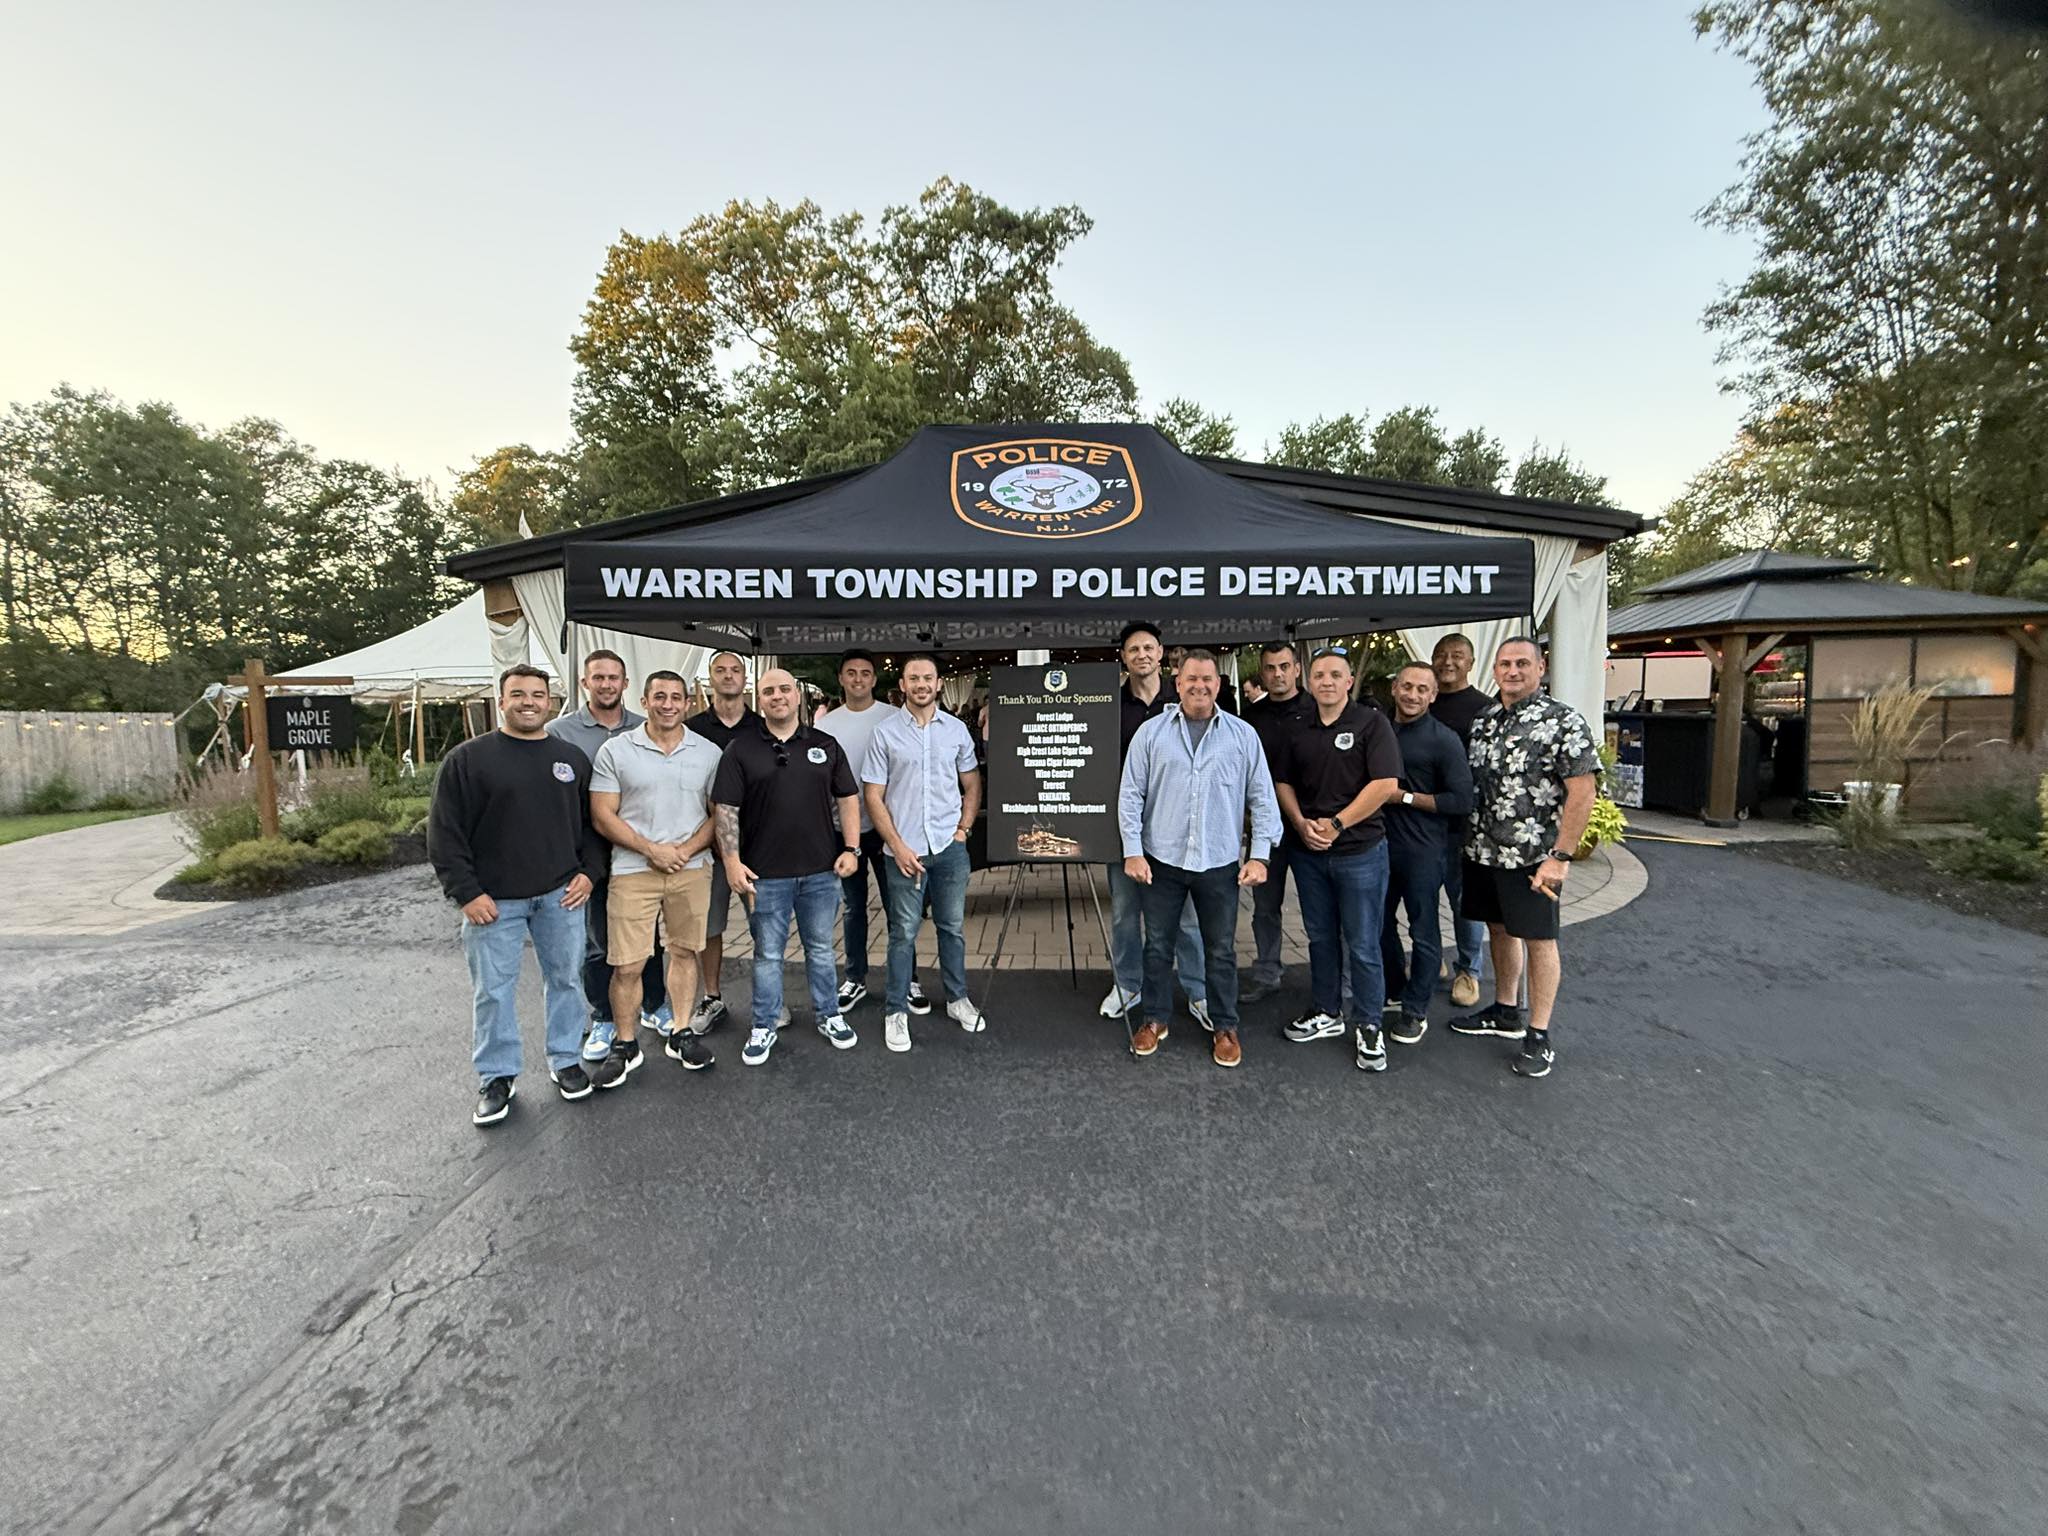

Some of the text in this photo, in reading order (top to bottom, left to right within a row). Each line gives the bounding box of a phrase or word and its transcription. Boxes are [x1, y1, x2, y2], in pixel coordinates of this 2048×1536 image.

[972, 446, 1112, 469] POLICE
[961, 479, 1129, 492] 19 72
[975, 500, 1121, 521] WARREN TWP.
[601, 565, 1500, 598] WARREN TOWNSHIP POLICE DEPARTMENT
[998, 694, 1112, 705] Thank You To Our Sponsors
[286, 710, 331, 726] MAPLE
[1037, 712, 1073, 722] Forest Lodge
[1022, 724, 1048, 733] ALLIANCE
[288, 728, 332, 745] GROVE
[1062, 746, 1078, 756] Cigar
[1047, 758, 1062, 768] Cigar
[1043, 780, 1065, 790] Everest
[1003, 804, 1106, 814] Washington Valley Fire Department
